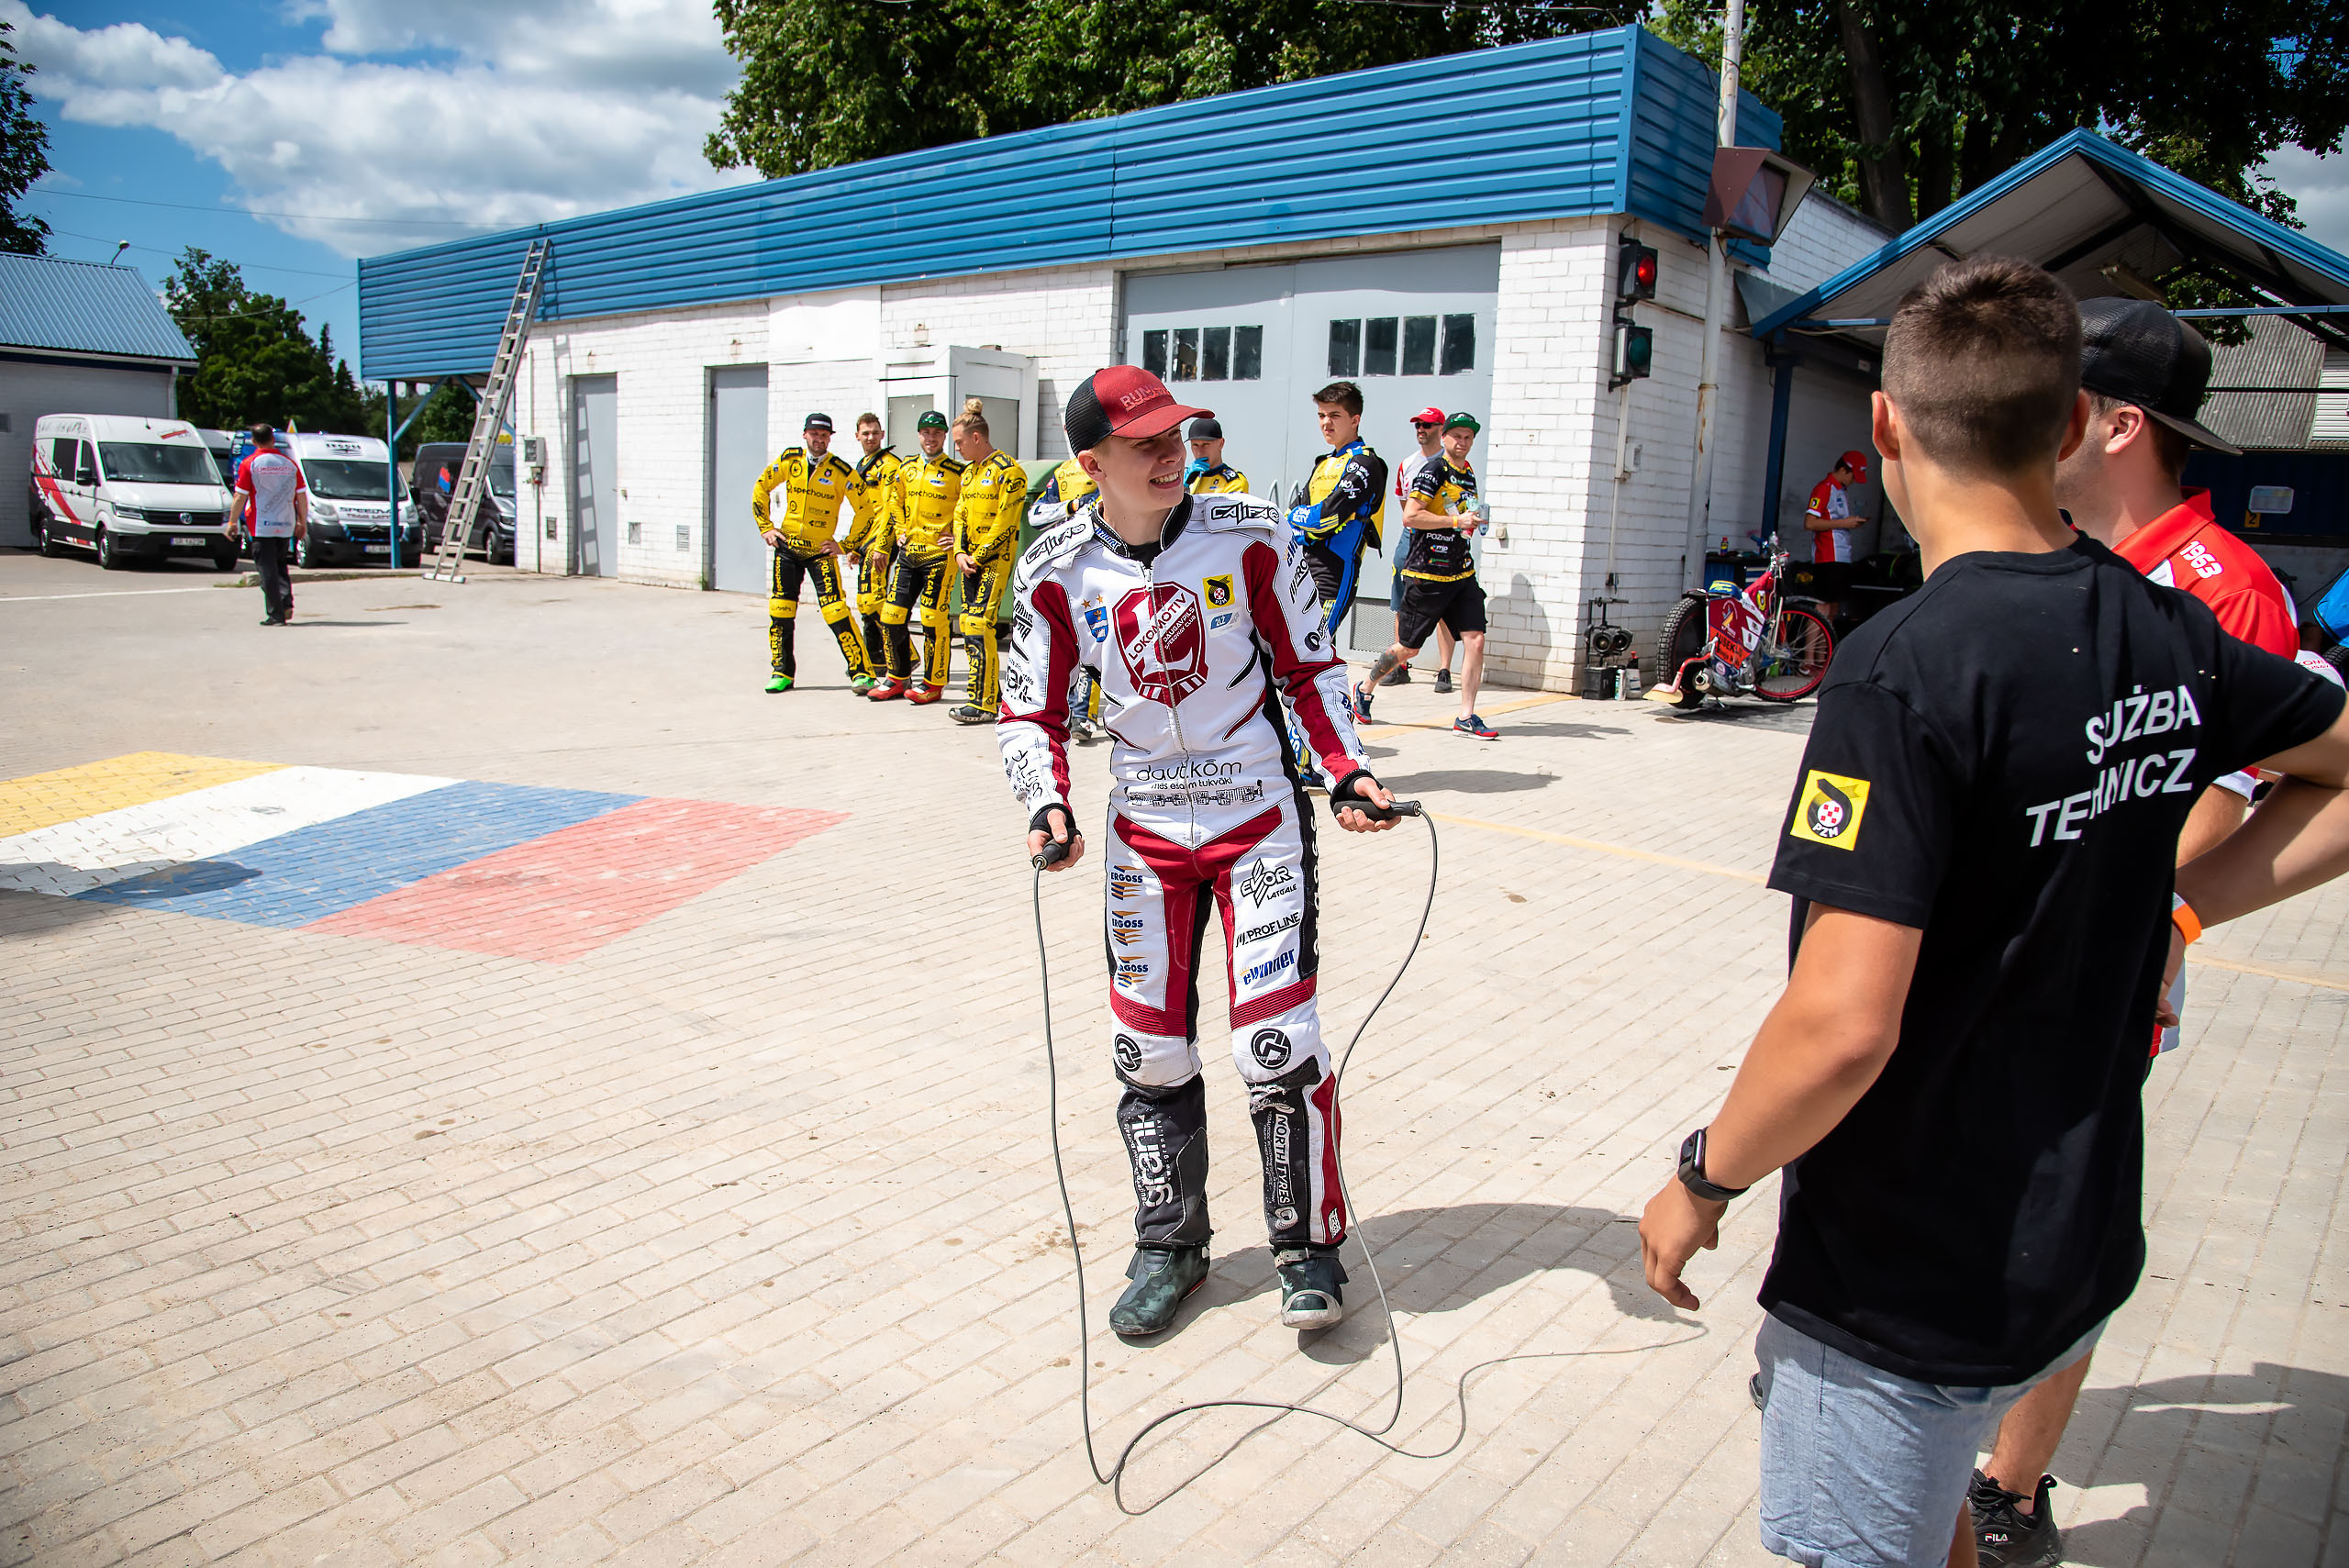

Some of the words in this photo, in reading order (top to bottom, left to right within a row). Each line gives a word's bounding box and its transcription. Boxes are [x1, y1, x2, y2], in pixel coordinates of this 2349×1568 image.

[2248, 513, 2257, 526] 2
[2179, 539, 2224, 579] 1963
[1128, 592, 1188, 661] LOKOMOTIV
[1163, 606, 1196, 643] DAUGAVPILS
[2085, 684, 2201, 765] SUŻBA
[1812, 822, 1839, 838] PZM
[1111, 872, 1143, 884] ERGOSS
[1266, 884, 1297, 900] LATGALE
[1112, 918, 1144, 929] ERGOSS
[1119, 964, 1149, 973] RGOSS
[1275, 1115, 1288, 1162] NORTH
[1277, 1163, 1291, 1204] TYRES
[1984, 1533, 2009, 1542] FILA
